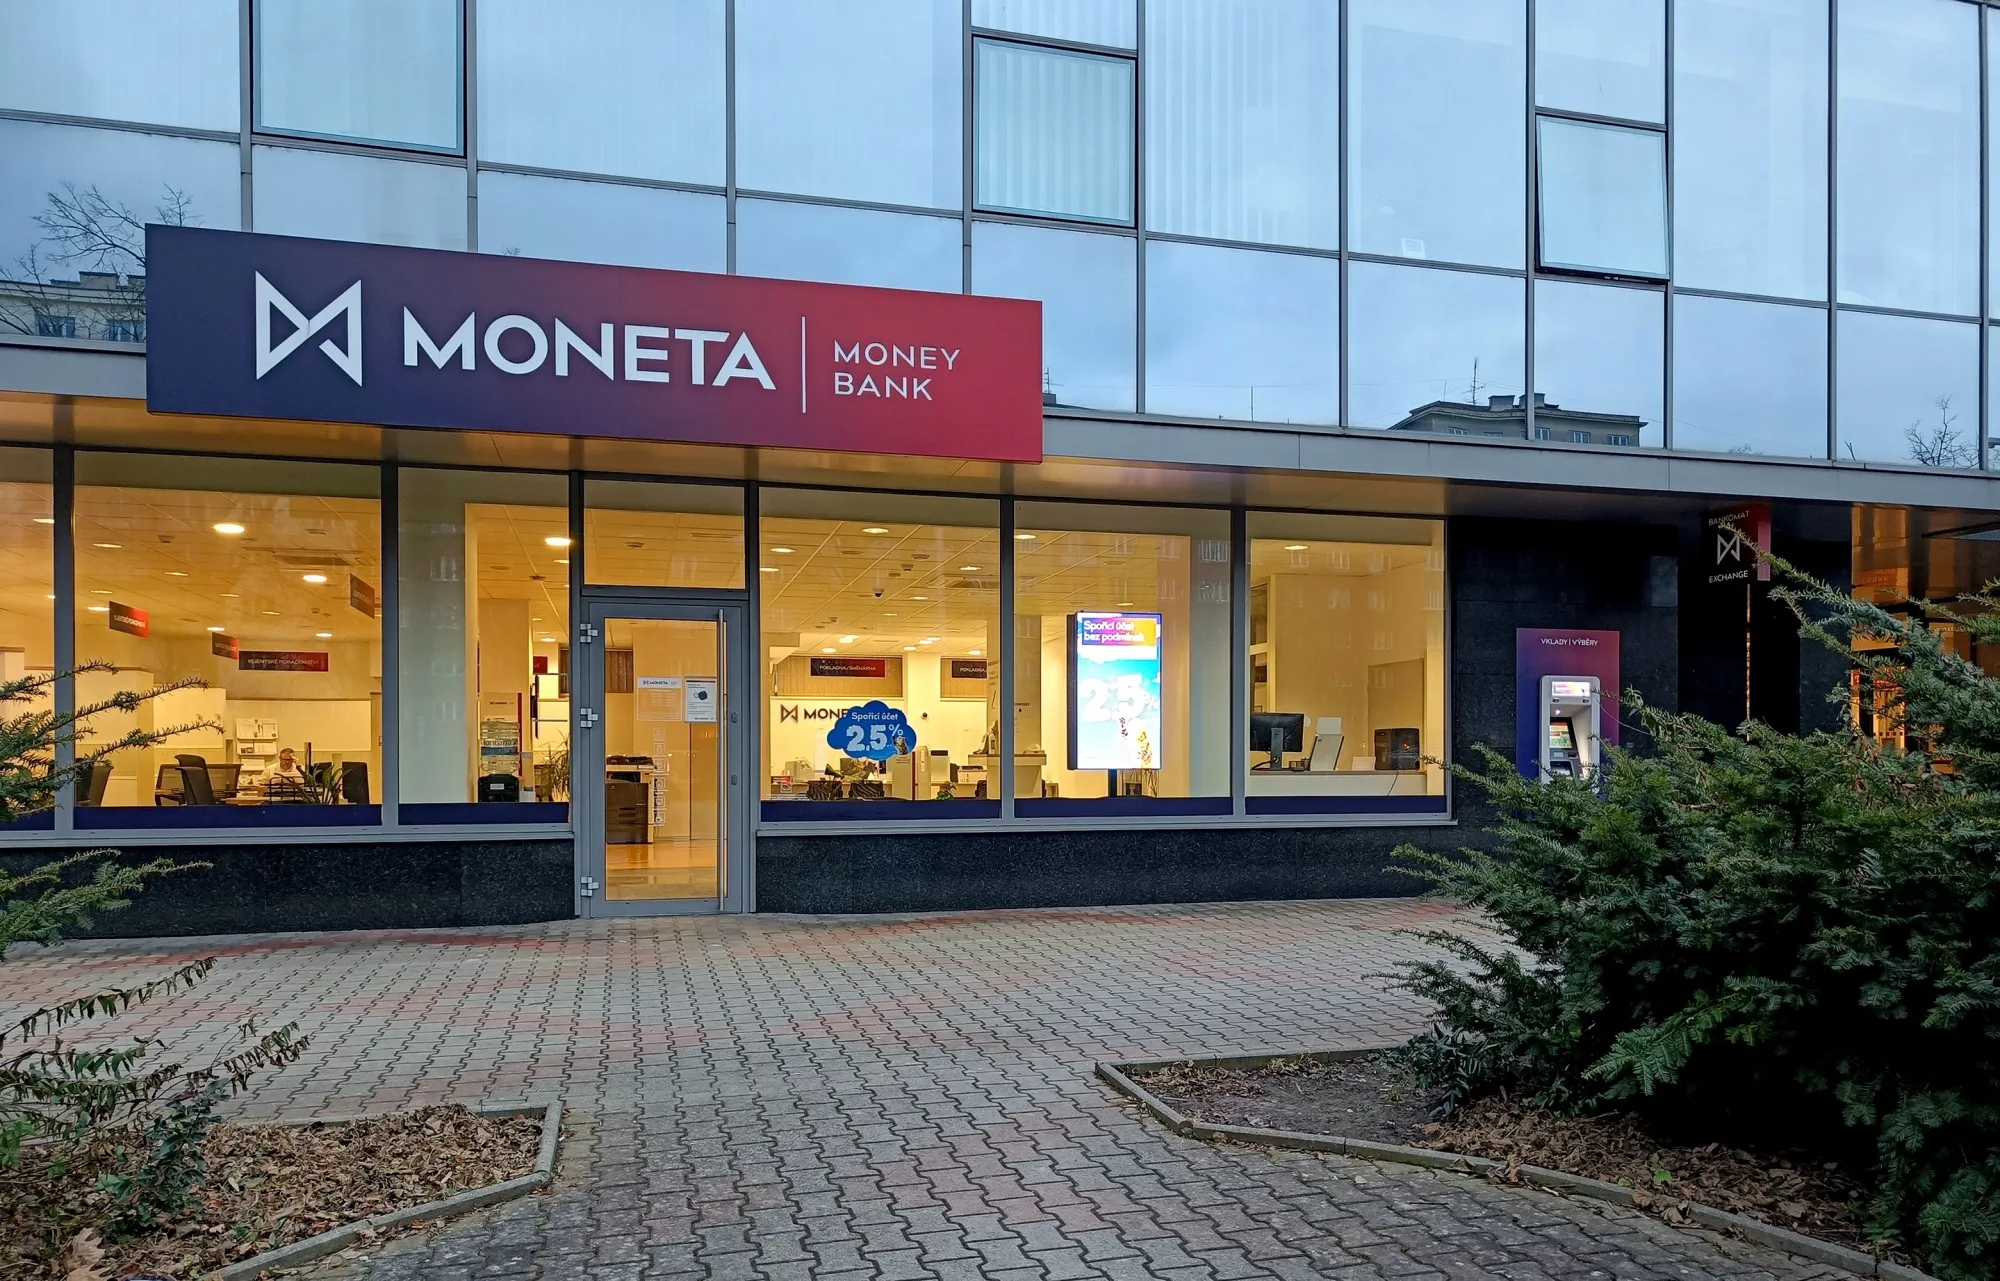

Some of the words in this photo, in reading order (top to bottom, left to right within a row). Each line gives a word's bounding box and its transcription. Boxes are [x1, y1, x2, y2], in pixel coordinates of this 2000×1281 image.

[403, 305, 777, 391] MONETA
[834, 339, 961, 371] MONEY
[834, 371, 933, 401] BANK
[1708, 510, 1750, 526] BANKOMAT
[1709, 570, 1748, 583] EXCHANGE
[1572, 637, 1598, 647] VÝBĚRY
[803, 708, 849, 720] MONE
[851, 712, 880, 722] Spořicí
[881, 711, 899, 721] účet
